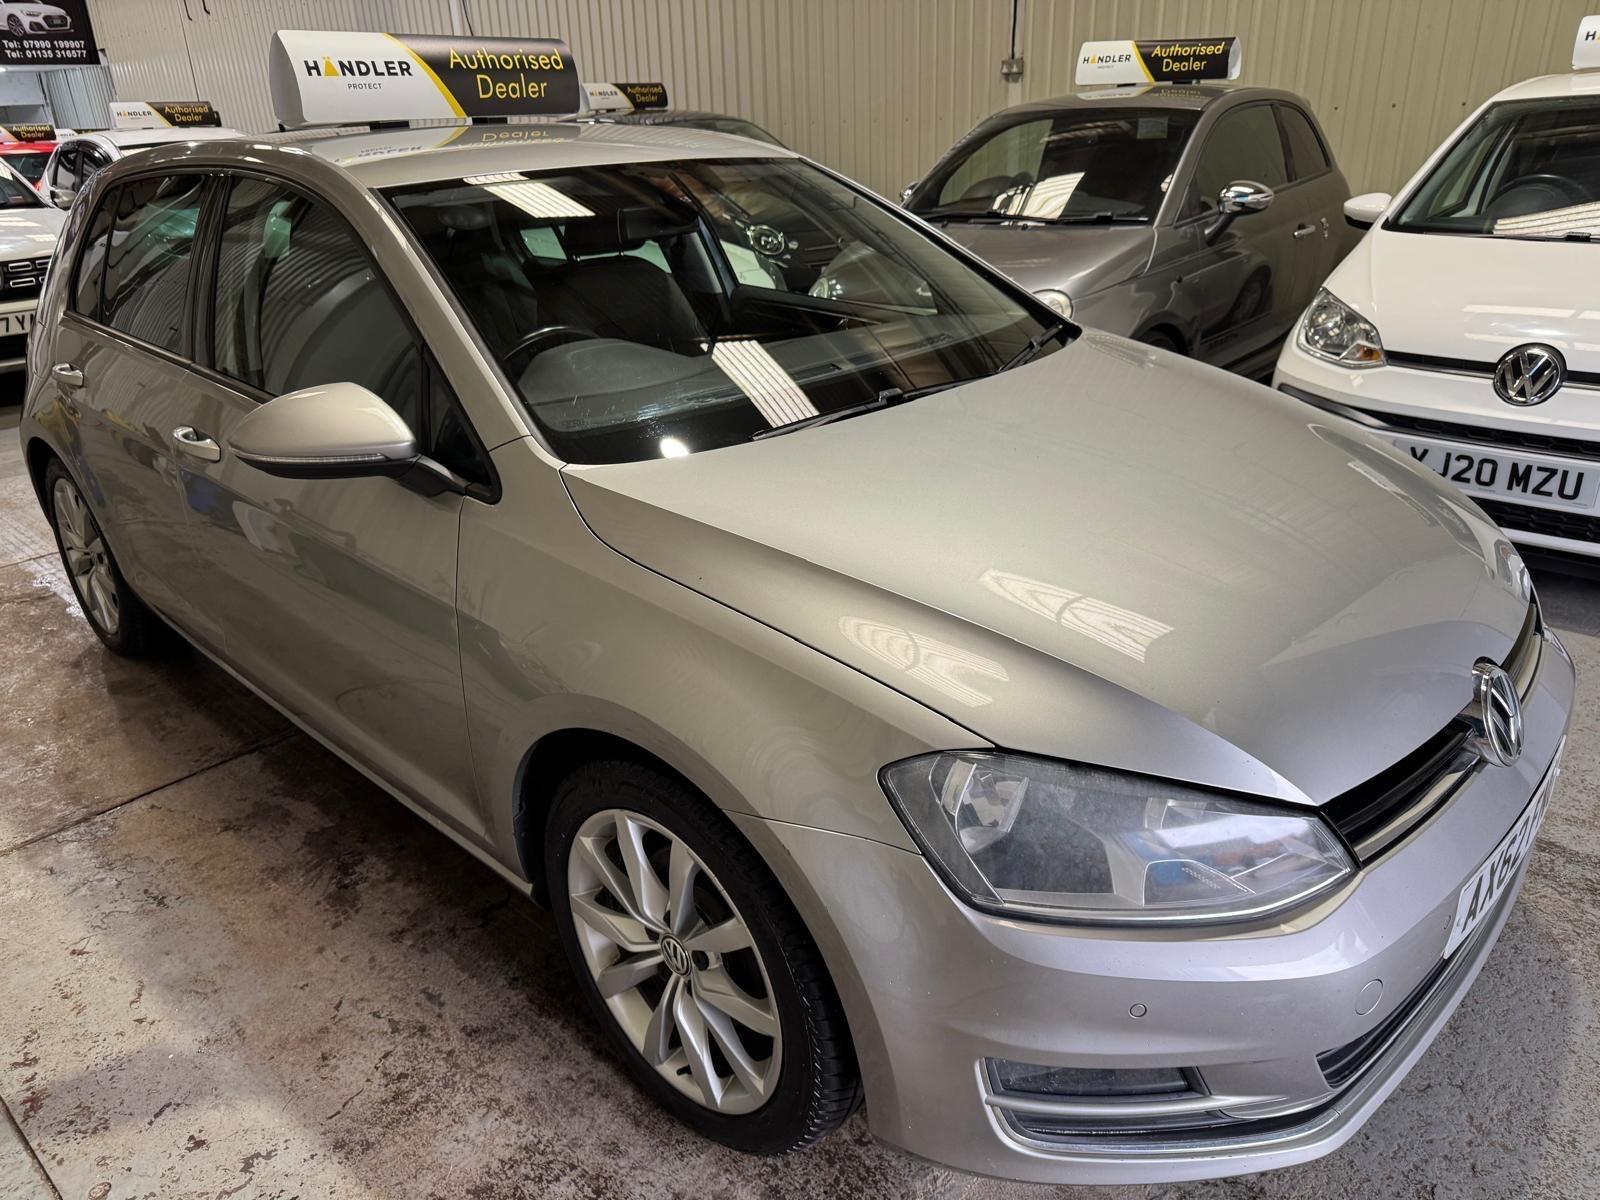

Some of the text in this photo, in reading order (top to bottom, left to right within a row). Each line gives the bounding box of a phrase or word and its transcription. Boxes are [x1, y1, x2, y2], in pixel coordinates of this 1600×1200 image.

[2, 40, 85, 49] Tel: 07990 199907
[1151, 41, 1225, 58] Authorised
[5, 50, 87, 58] Tel: 01135 316577
[448, 47, 564, 70] Authorised
[1162, 58, 1207, 73] Dealer
[347, 82, 382, 90] PROTECT
[476, 72, 548, 99] Dealer
[164, 104, 209, 114] Authorised
[174, 113, 203, 122] Dealer
[20, 130, 45, 138] Dealer
[1506, 462, 1585, 501] MZU
